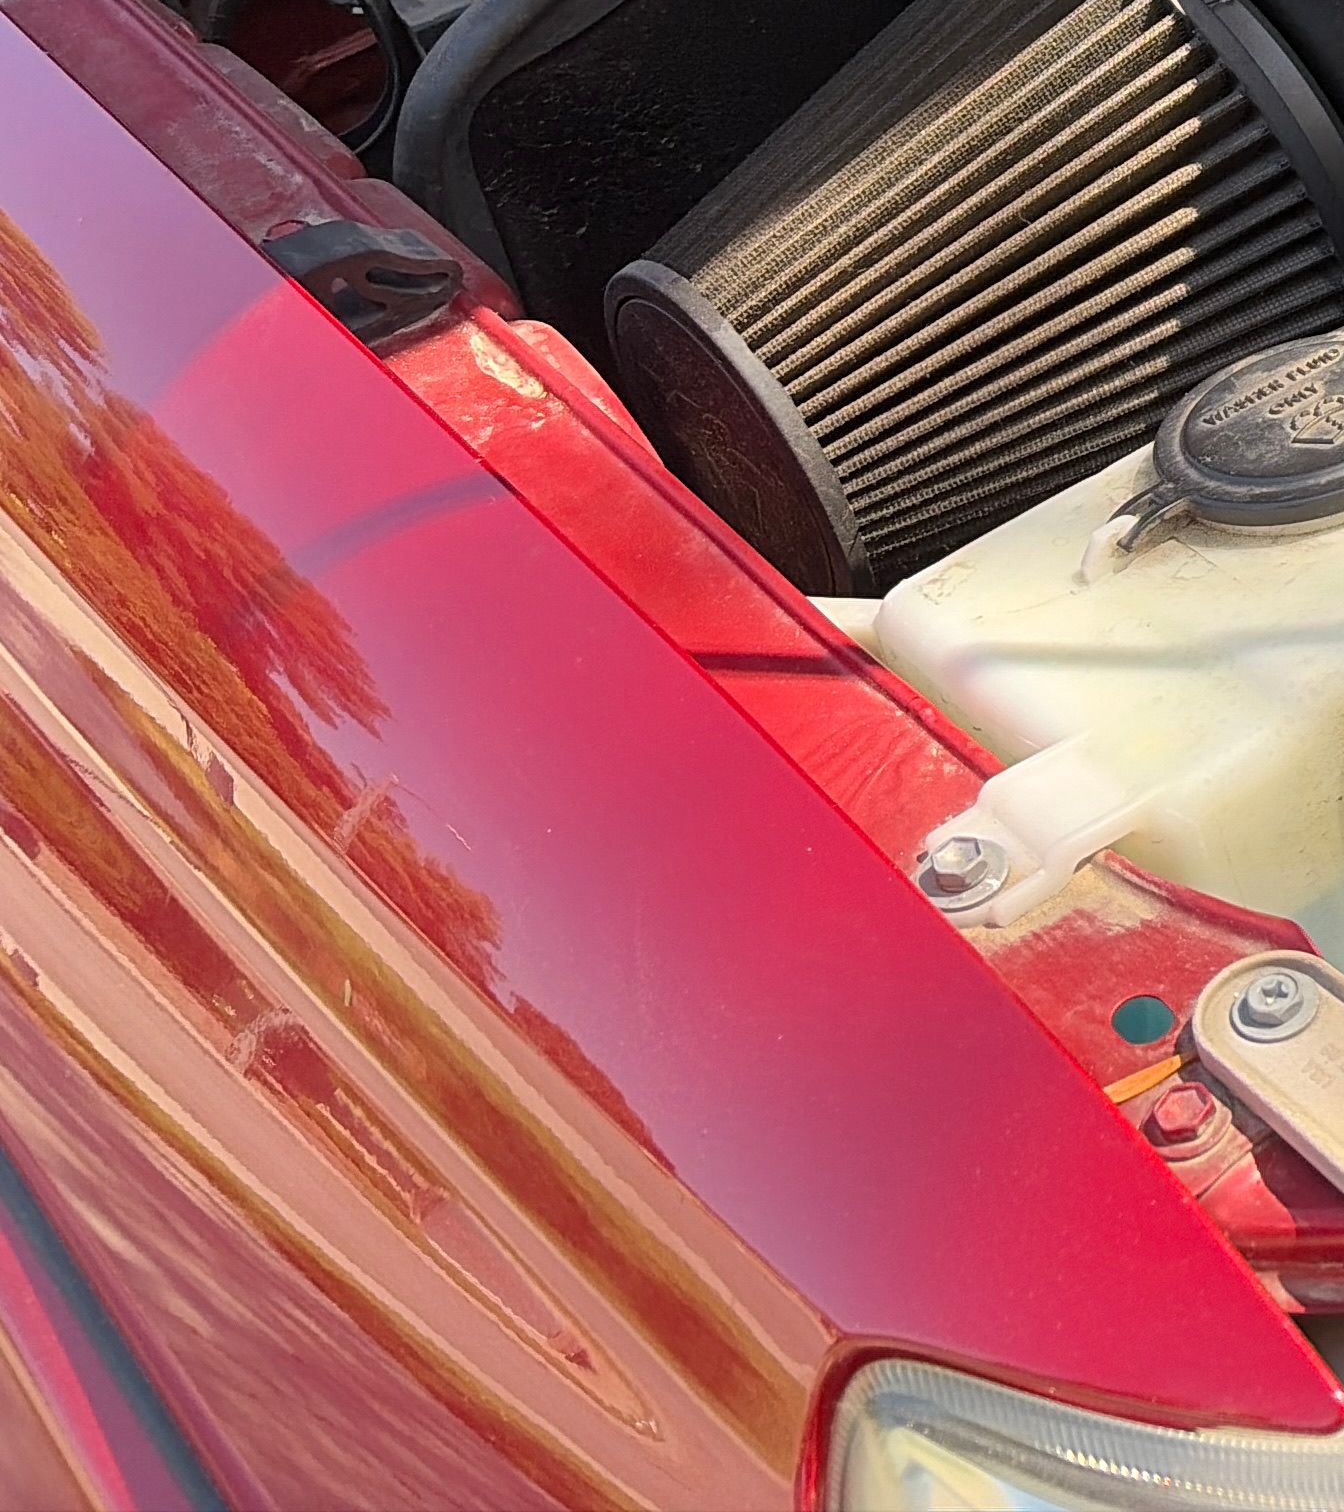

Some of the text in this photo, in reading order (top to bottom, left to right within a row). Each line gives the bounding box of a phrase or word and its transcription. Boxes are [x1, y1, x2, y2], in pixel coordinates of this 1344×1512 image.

[1202, 347, 1342, 427] WASHER FLUID
[1267, 382, 1319, 416] ONLY
